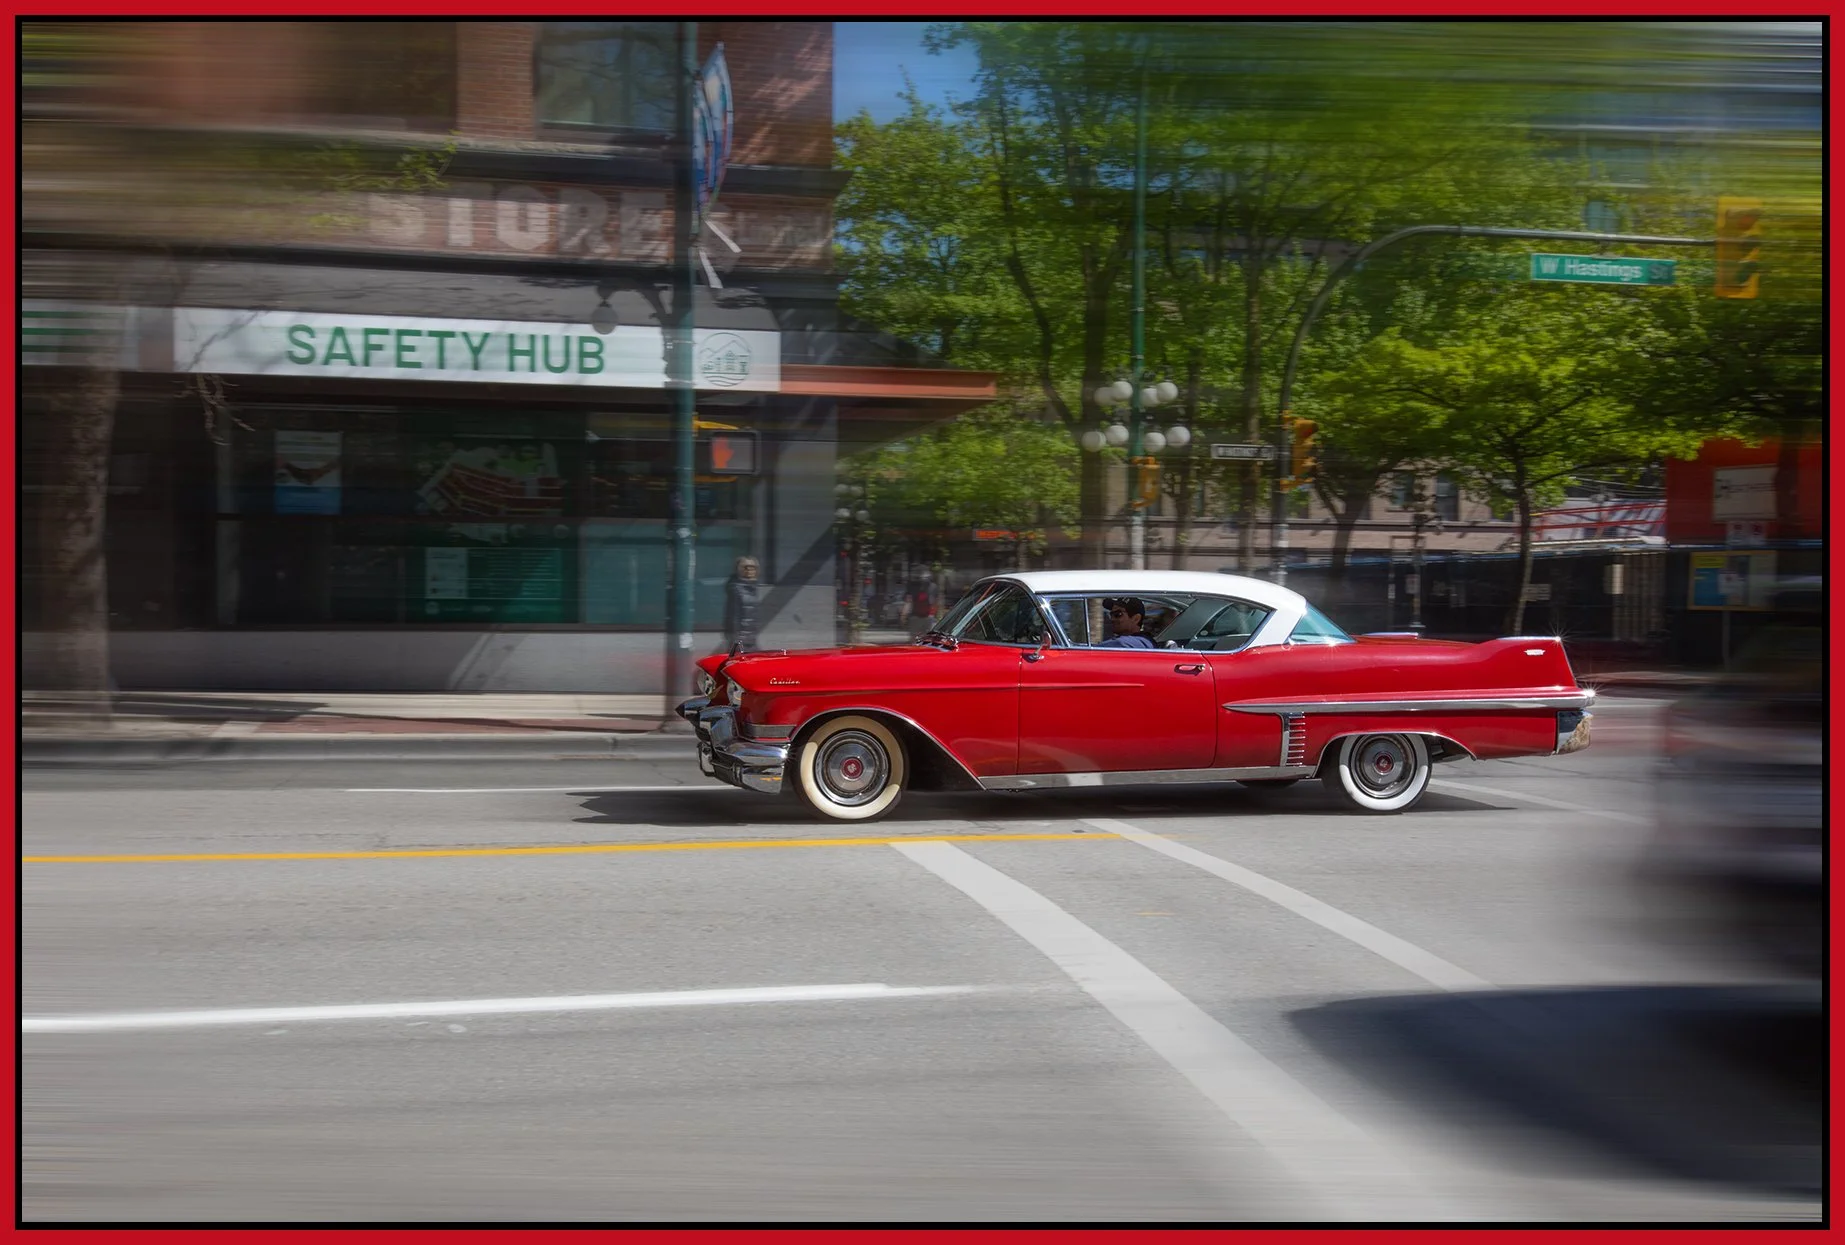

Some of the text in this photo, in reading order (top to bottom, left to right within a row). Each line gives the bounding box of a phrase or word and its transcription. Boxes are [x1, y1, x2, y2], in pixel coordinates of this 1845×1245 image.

[1539, 257, 1670, 281] W Hastings St
[287, 324, 605, 374] SAFETY HUB
